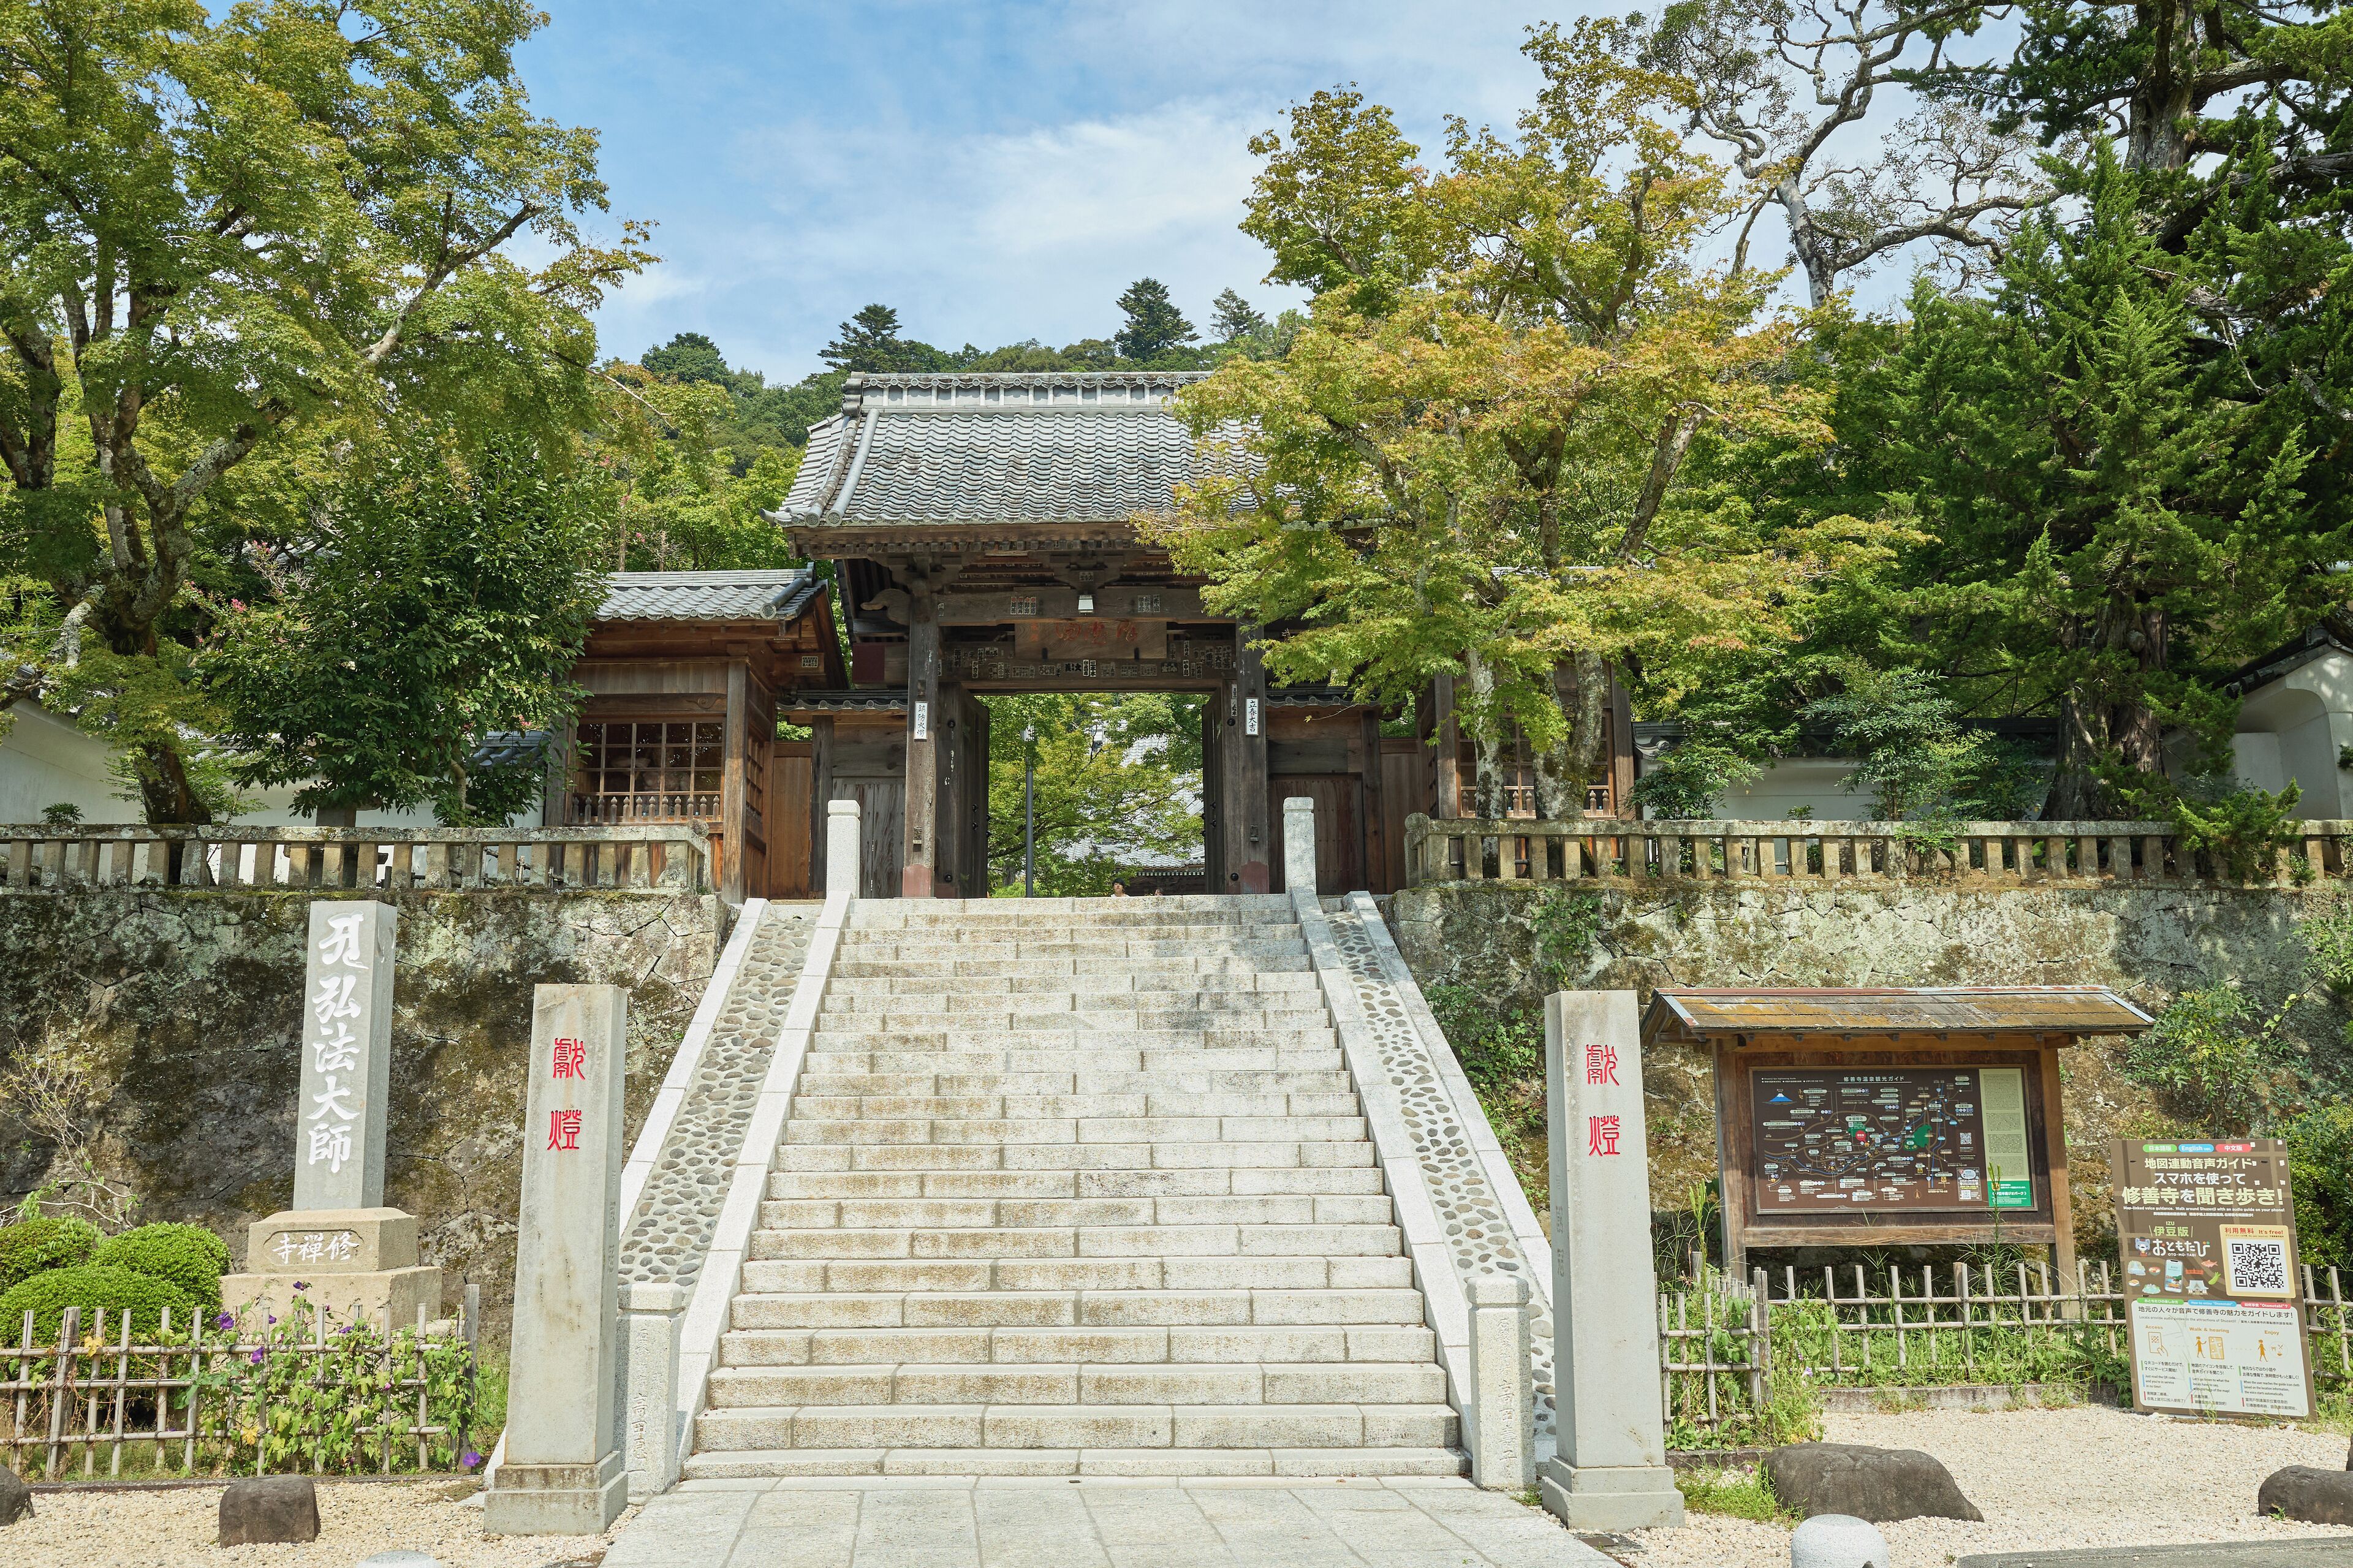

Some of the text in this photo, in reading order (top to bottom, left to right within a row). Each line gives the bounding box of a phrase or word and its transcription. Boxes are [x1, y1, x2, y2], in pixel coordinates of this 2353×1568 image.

[1248, 700, 1257, 732] 立春大吉
[2145, 1157, 2253, 1169] 地図連動音声ガイド
[2154, 1172, 2246, 1185] スマホを使って
[2153, 1226, 2189, 1237] 伊豆版
[2152, 1238, 2210, 1257] おともたび
